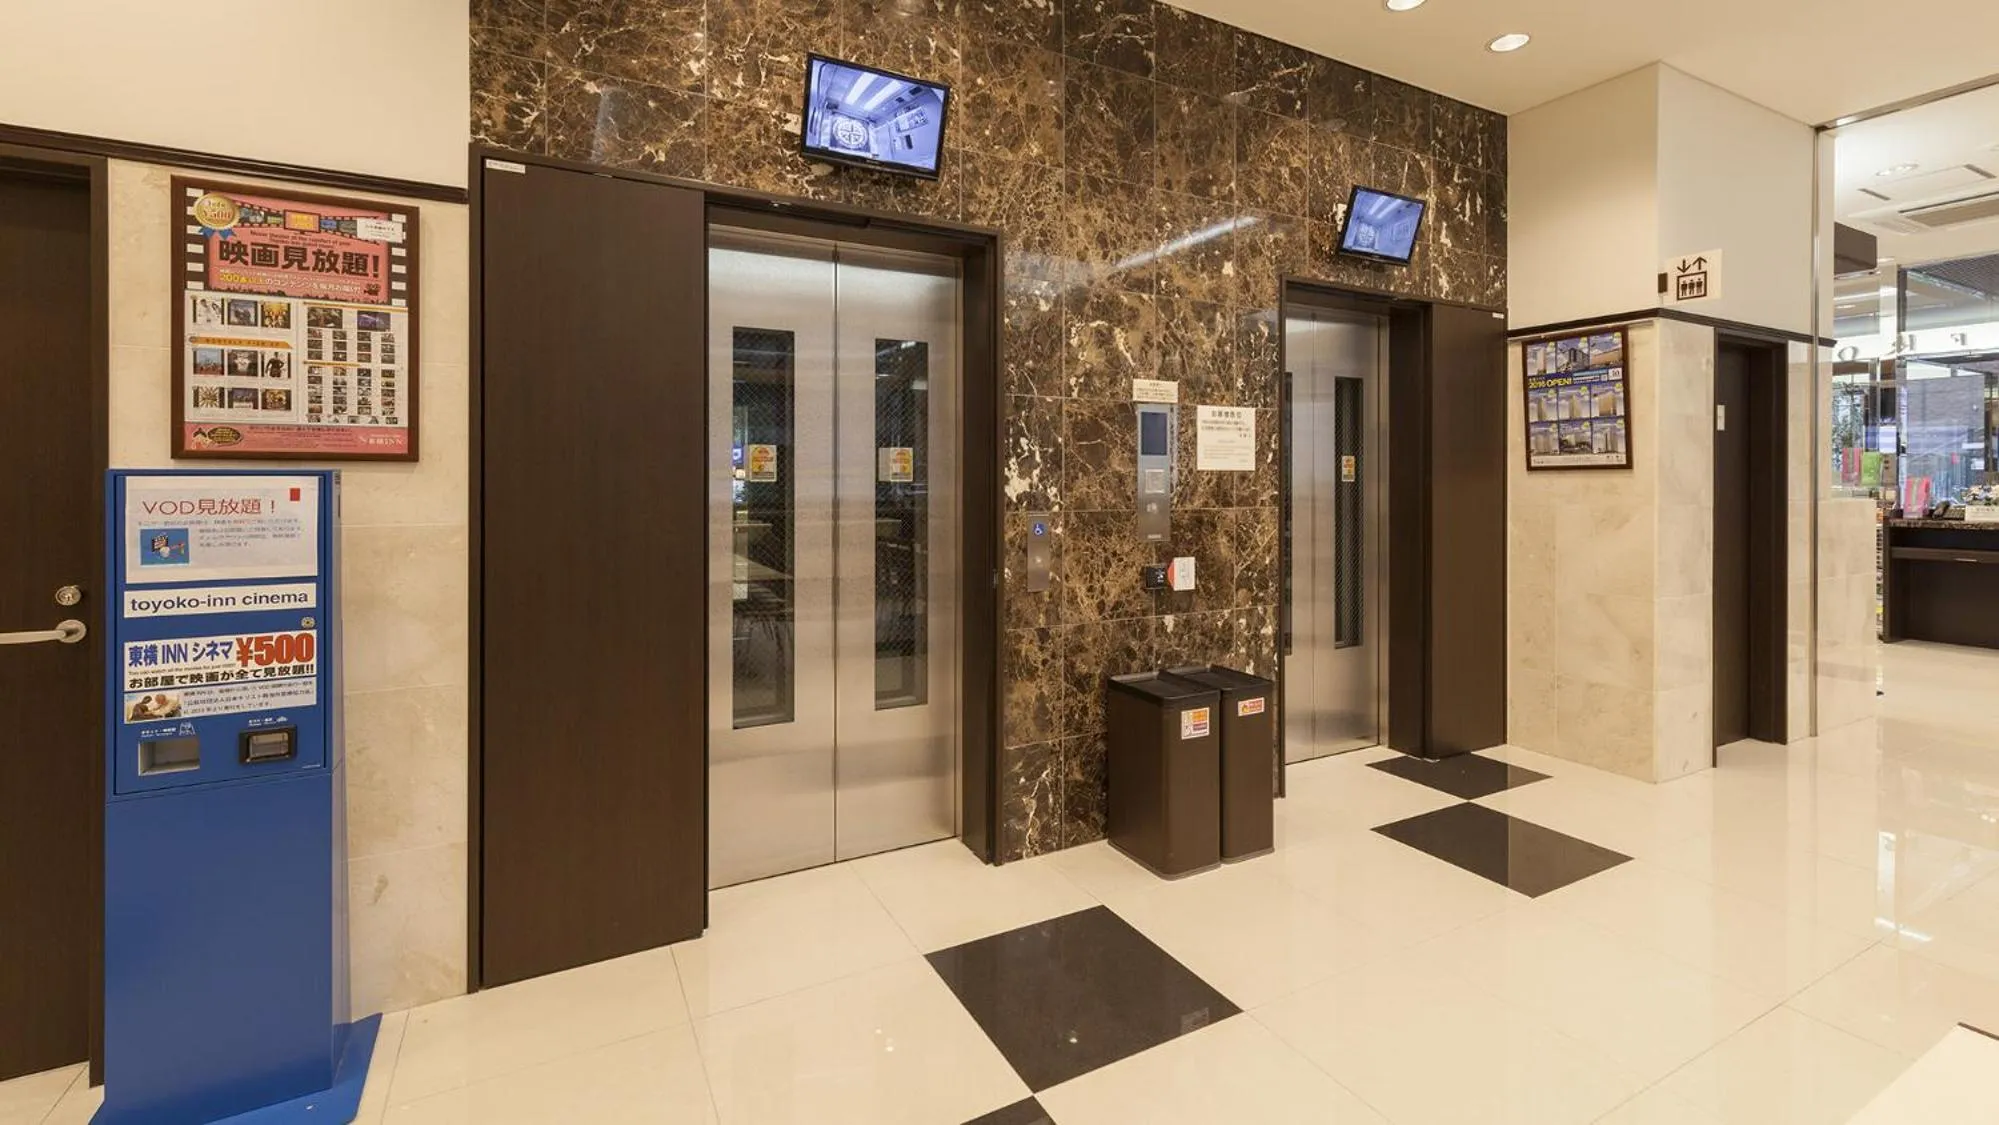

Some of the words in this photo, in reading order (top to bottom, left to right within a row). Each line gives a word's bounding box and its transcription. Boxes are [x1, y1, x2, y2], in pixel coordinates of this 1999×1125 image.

[218, 239, 380, 278] 映画見放題!
[131, 594, 236, 614] toyoko-inn
[241, 591, 309, 605] cinema
[128, 643, 158, 667] 東横
[161, 643, 189, 664] INN
[192, 640, 233, 663] シネマ
[236, 632, 315, 667] ¥500
[128, 664, 314, 689] お部屋で映画が全て見放題!!
